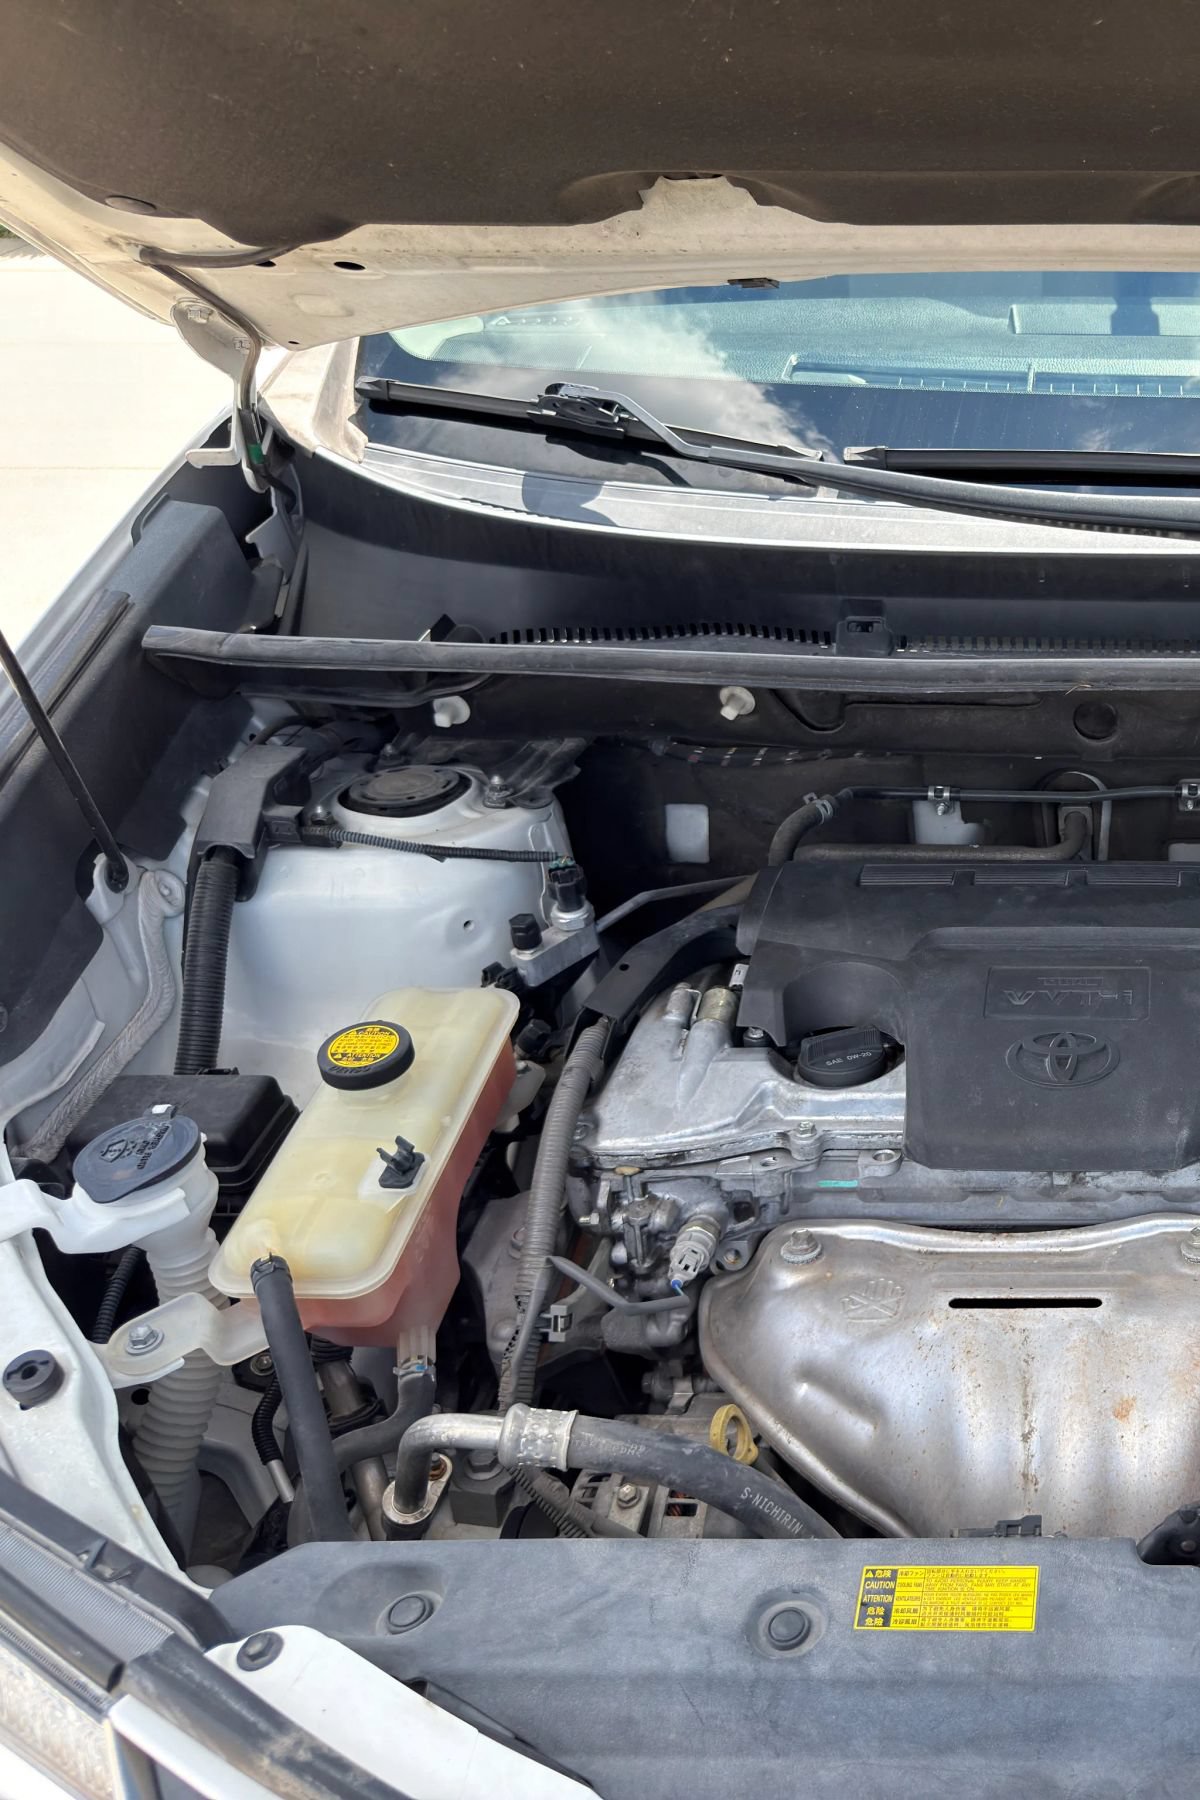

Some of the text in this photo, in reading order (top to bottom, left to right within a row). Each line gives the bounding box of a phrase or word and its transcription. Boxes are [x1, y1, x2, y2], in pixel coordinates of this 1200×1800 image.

[826, 1058, 844, 1066] SAE
[865, 1581, 896, 1589] CAUTION
[863, 1594, 894, 1603] ATTENTION
